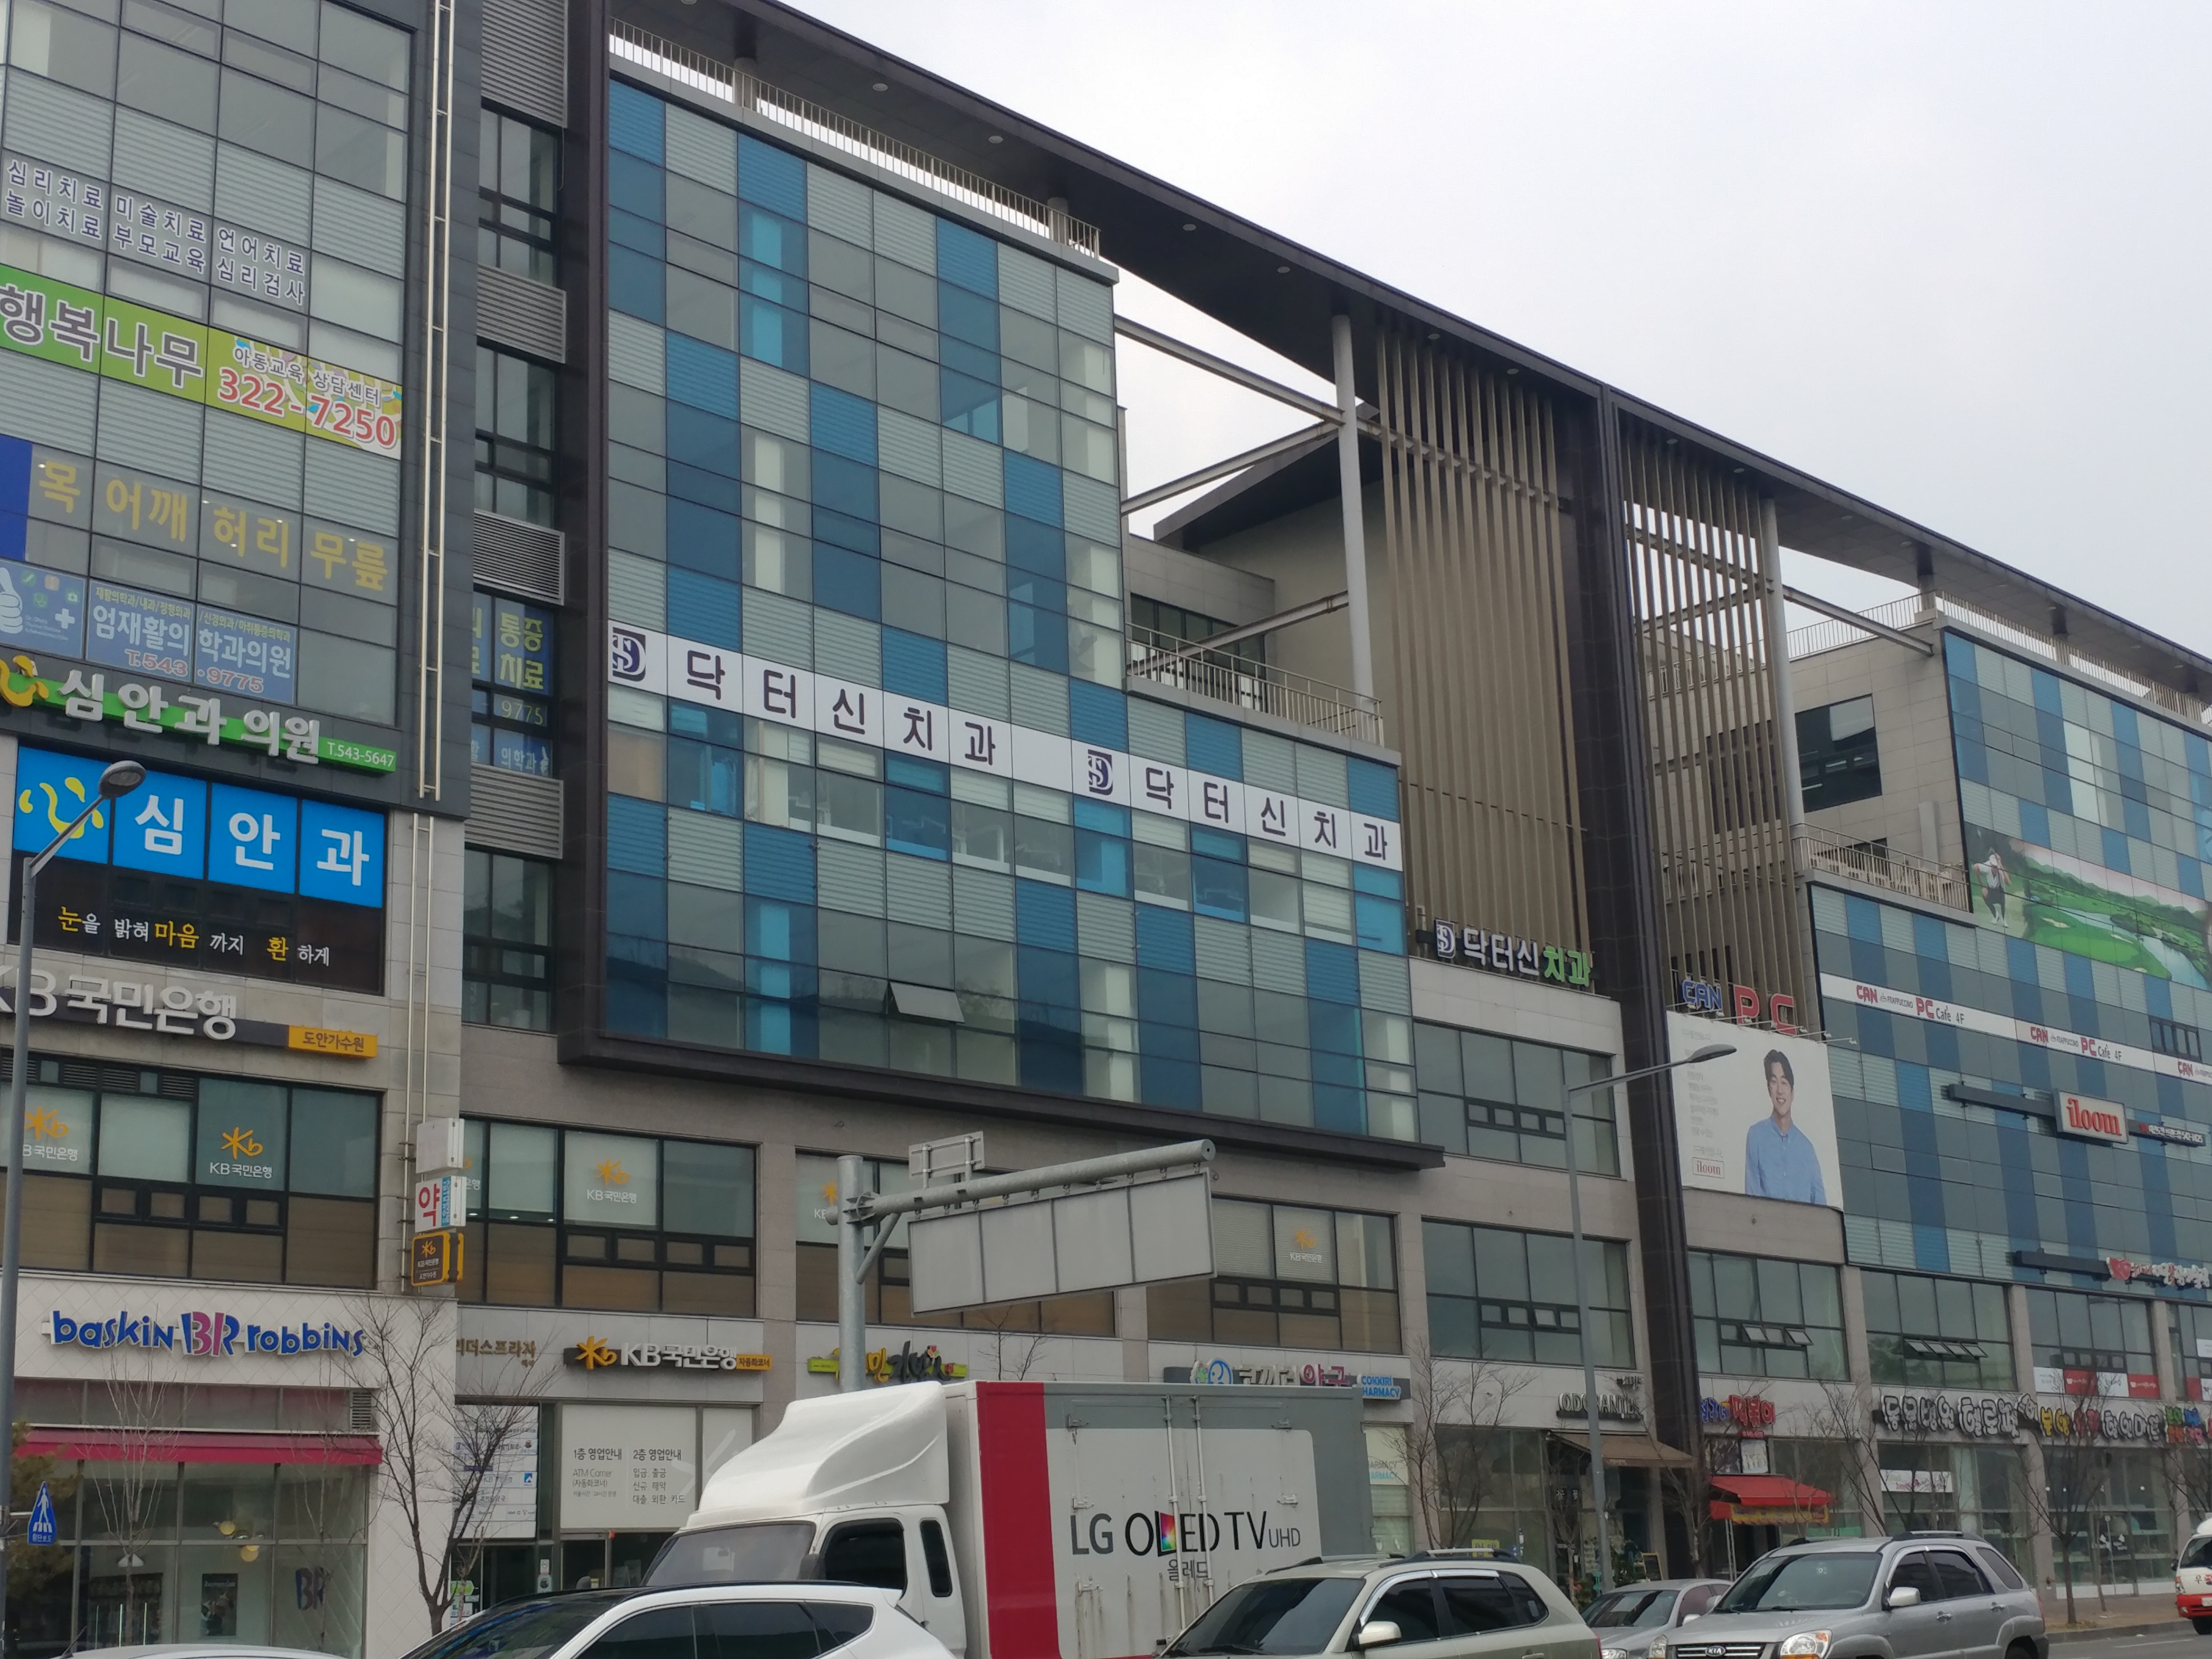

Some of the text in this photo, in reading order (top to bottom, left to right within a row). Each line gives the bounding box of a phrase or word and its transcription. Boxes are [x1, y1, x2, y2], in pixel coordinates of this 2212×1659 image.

[7, 159, 305, 276] 심리치료 미술치료 언어치료
[5, 190, 305, 305] 놀이치료 부모교육 심리검사
[0, 285, 203, 390] 행복나무
[233, 345, 380, 406] 아동교육 상담센터
[219, 369, 397, 449] 322-7250
[39, 460, 388, 591] 목 어깨 허리 무릎
[500, 612, 543, 651] 통증
[500, 653, 544, 690] 치료
[501, 700, 543, 725] 9775
[686, 649, 996, 766] 닥터신치과
[327, 742, 395, 768] T.543-5647
[1145, 767, 1388, 861] 닥터신치과
[135, 793, 371, 887] 심안과
[57, 906, 101, 935] 눈을
[210, 933, 244, 956] 까지
[298, 944, 330, 967] 하게
[1463, 927, 1591, 987] 닥터신치과
[1682, 980, 1798, 1035] CAN PC
[1856, 985, 1878, 1004] CAN
[1916, 997, 1934, 1019] PC
[1956, 1012, 1964, 1024] 4F
[303, 1031, 364, 1053] 도안가수원
[2031, 1026, 2049, 1043] CAN
[2080, 1037, 2097, 1056] PC
[2177, 1061, 2194, 1077] CAN
[2067, 1098, 2121, 1136] iloom
[1697, 1160, 1721, 1175] iloom
[419, 1182, 440, 1227] 약
[51, 1310, 174, 1352] baskin
[245, 1322, 365, 1357] robbins
[1362, 1387, 1400, 1397] HARMACY
[572, 1468, 589, 1477] ATM
[573, 1448, 622, 1461] 1층 영업안내
[633, 1449, 681, 1461] 2층 영업안내
[671, 1495, 686, 1504] 카드
[1070, 1511, 1301, 1558] LG OLED TV UHD
[1167, 1559, 1209, 1581] 올레드
